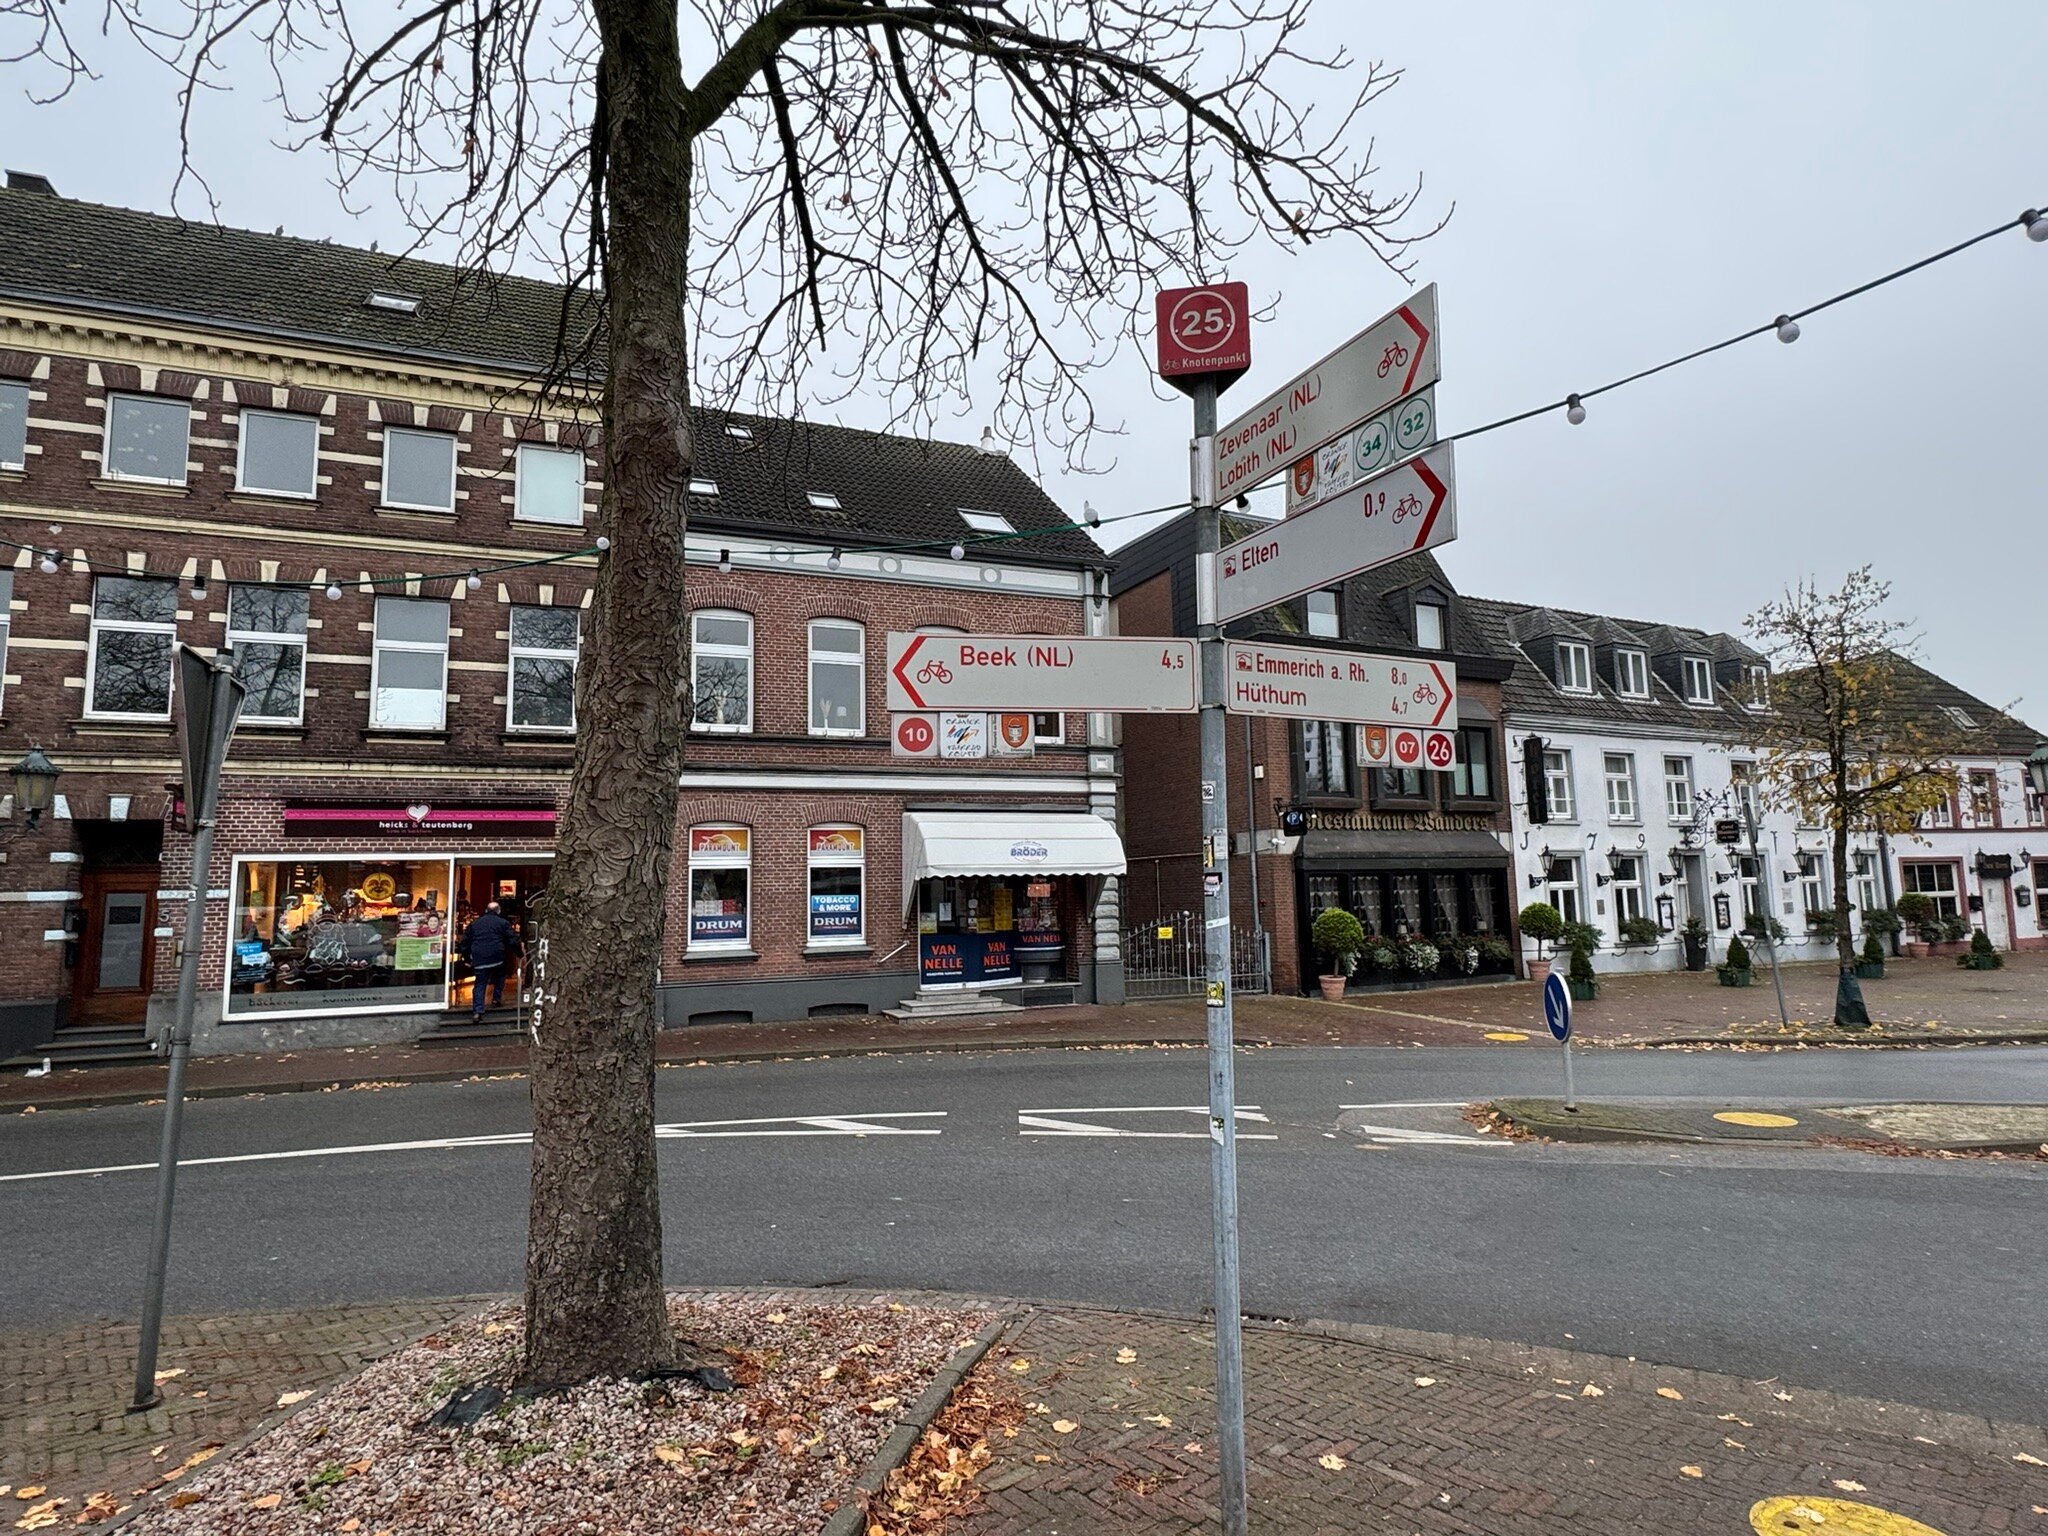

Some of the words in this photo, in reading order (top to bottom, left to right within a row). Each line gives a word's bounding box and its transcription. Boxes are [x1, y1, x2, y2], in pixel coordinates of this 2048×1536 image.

[1182, 308, 1224, 336] 25
[1182, 352, 1246, 368] Knotenpunkt
[1219, 405, 1283, 460] Zevenaar
[1289, 374, 1321, 415] (NL)
[1403, 412, 1424, 436] 32
[1363, 434, 1382, 457] 34
[1219, 451, 1260, 490] Lobith
[1266, 425, 1297, 462] (NL)
[1364, 492, 1386, 517] 0,9
[1242, 541, 1279, 571] Elten
[960, 645, 1017, 667] Beek
[1027, 645, 1074, 668] (NL)
[1161, 650, 1184, 670] 4,5
[1256, 653, 1325, 679] Emmerich
[1331, 665, 1343, 680] a.
[1349, 662, 1370, 683] Rh.
[1391, 667, 1408, 685] 8,0
[1236, 681, 1307, 706] Hüthum
[1391, 696, 1408, 715] 4,7
[905, 728, 928, 742] 10
[1400, 741, 1416, 754] 07
[1429, 740, 1450, 761] 26
[421, 821, 473, 830] teutenberg
[1307, 812, 1411, 831] Restaurant
[1414, 811, 1490, 832] Wanders
[698, 842, 741, 852] PARAMOUNT
[816, 842, 855, 851] PARAMOUNT
[1010, 846, 1048, 856] BRÖDER
[814, 896, 856, 904] TOBACCO
[826, 904, 852, 912] MORE
[160, 910, 170, 922] 5
[814, 917, 858, 926] DRUM
[695, 920, 743, 930] DRUM
[1022, 935, 1041, 943] VAN
[931, 945, 957, 956] VAN
[988, 942, 1006, 953] VAN
[925, 958, 964, 970] NELLE
[983, 954, 1012, 967] NELLE
